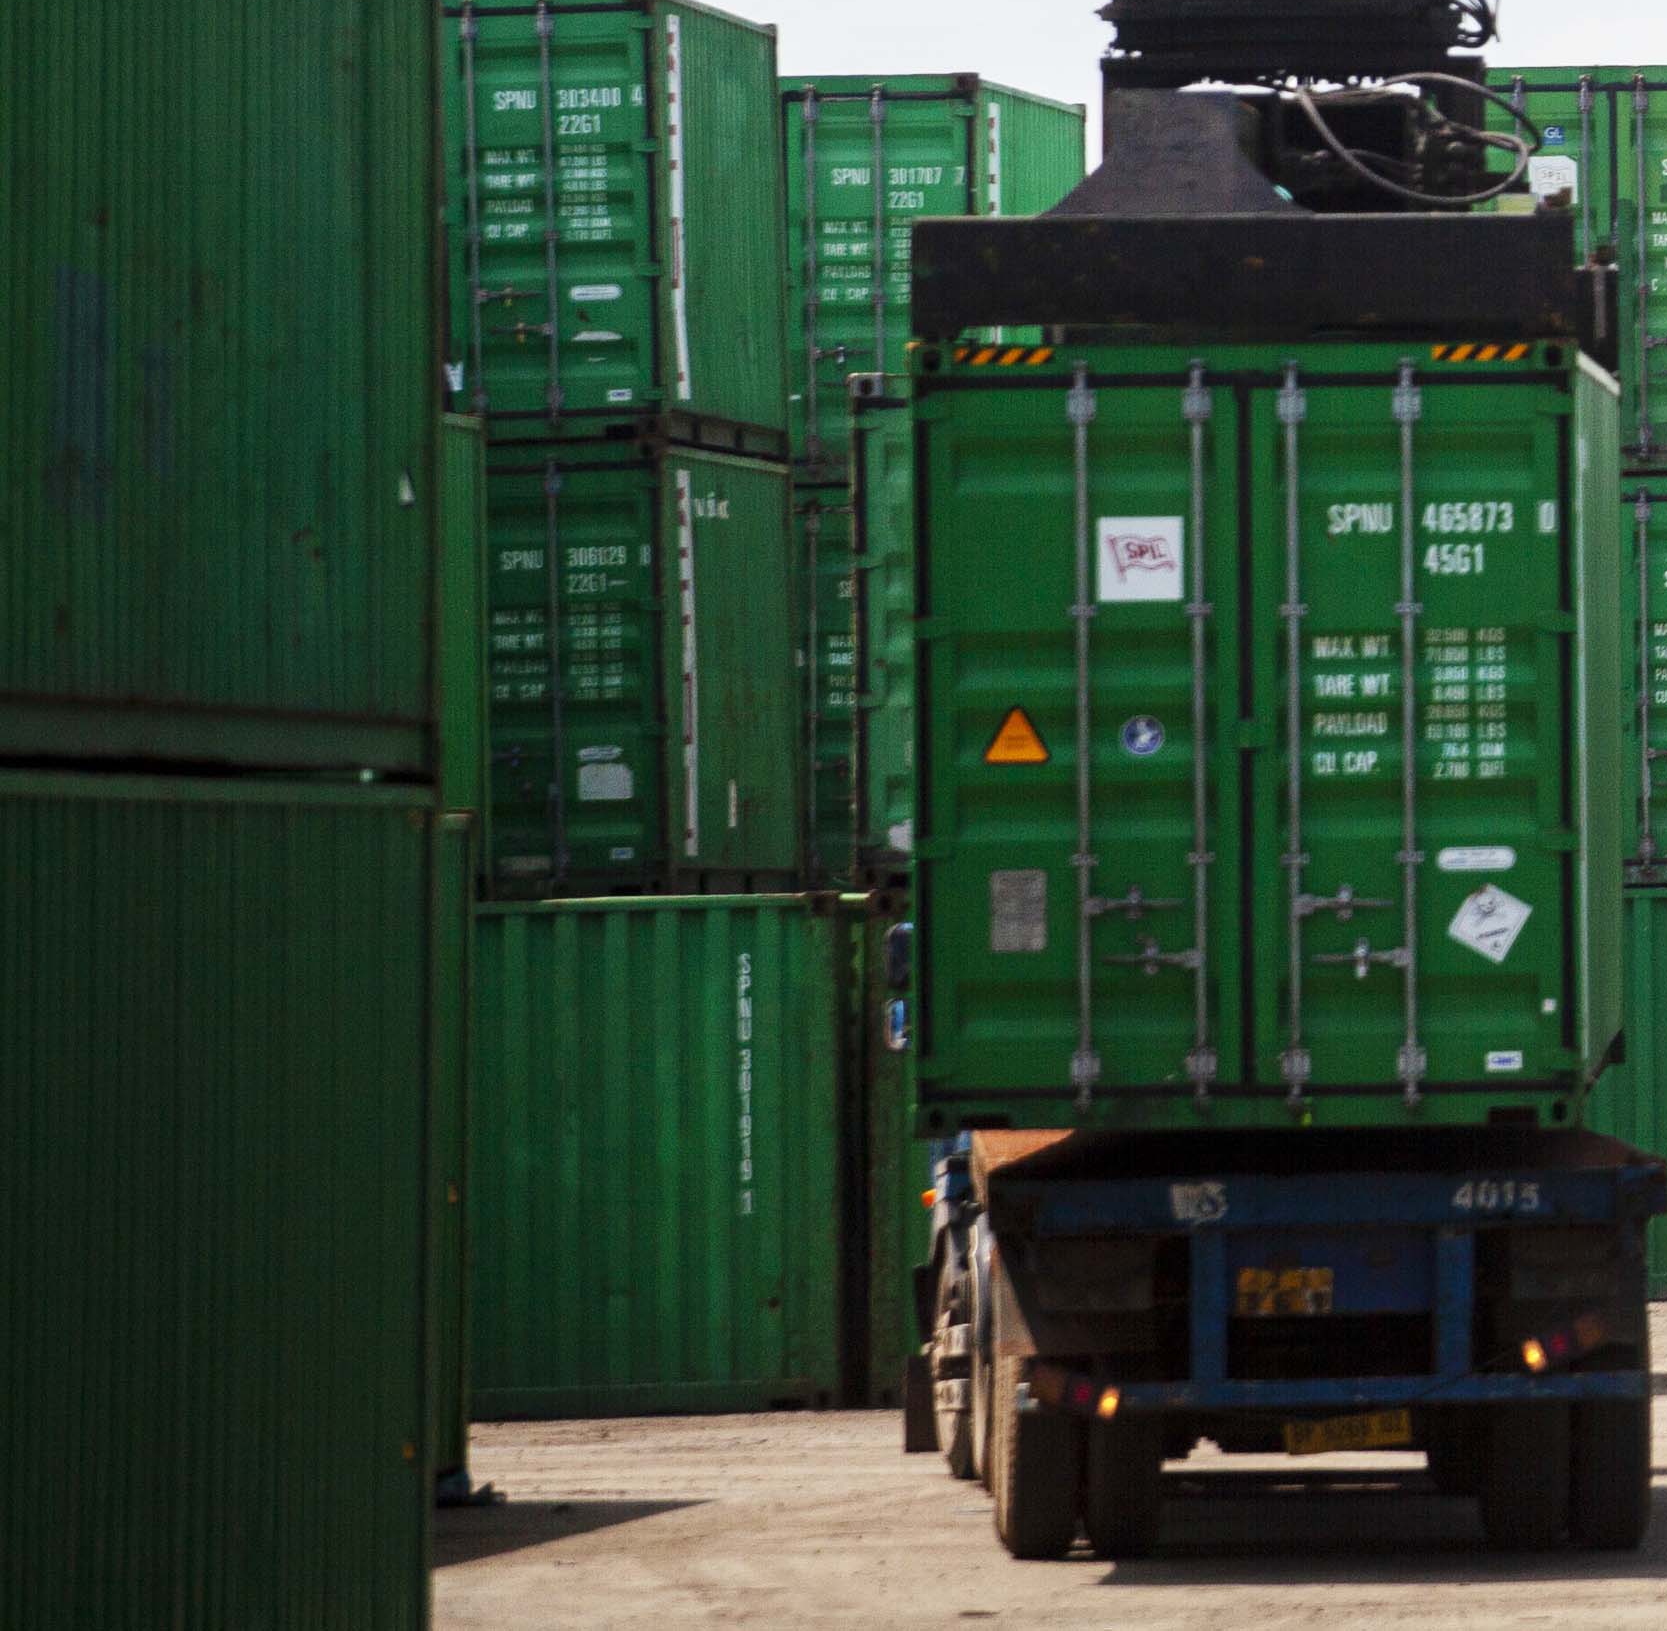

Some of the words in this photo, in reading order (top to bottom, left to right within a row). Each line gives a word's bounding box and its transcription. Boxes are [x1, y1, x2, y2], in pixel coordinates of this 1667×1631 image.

[494, 89, 537, 111] SPNU
[632, 84, 645, 106] 4
[559, 113, 601, 135] 22G1
[832, 168, 870, 185] SPNU
[889, 191, 924, 209] 22G1
[1328, 503, 1393, 533] SPNU
[1422, 502, 1513, 532] 465873
[500, 550, 545, 570] SPNU
[1126, 540, 1167, 560] SPIL
[1424, 543, 1484, 573] 45G1
[1476, 646, 1506, 661] LBS
[1313, 674, 1356, 697] TARE
[1476, 684, 1506, 701] LBS
[1313, 712, 1388, 736] PAYLOAD
[1476, 722, 1507, 739] LBS
[737, 953, 753, 1041] SPNU
